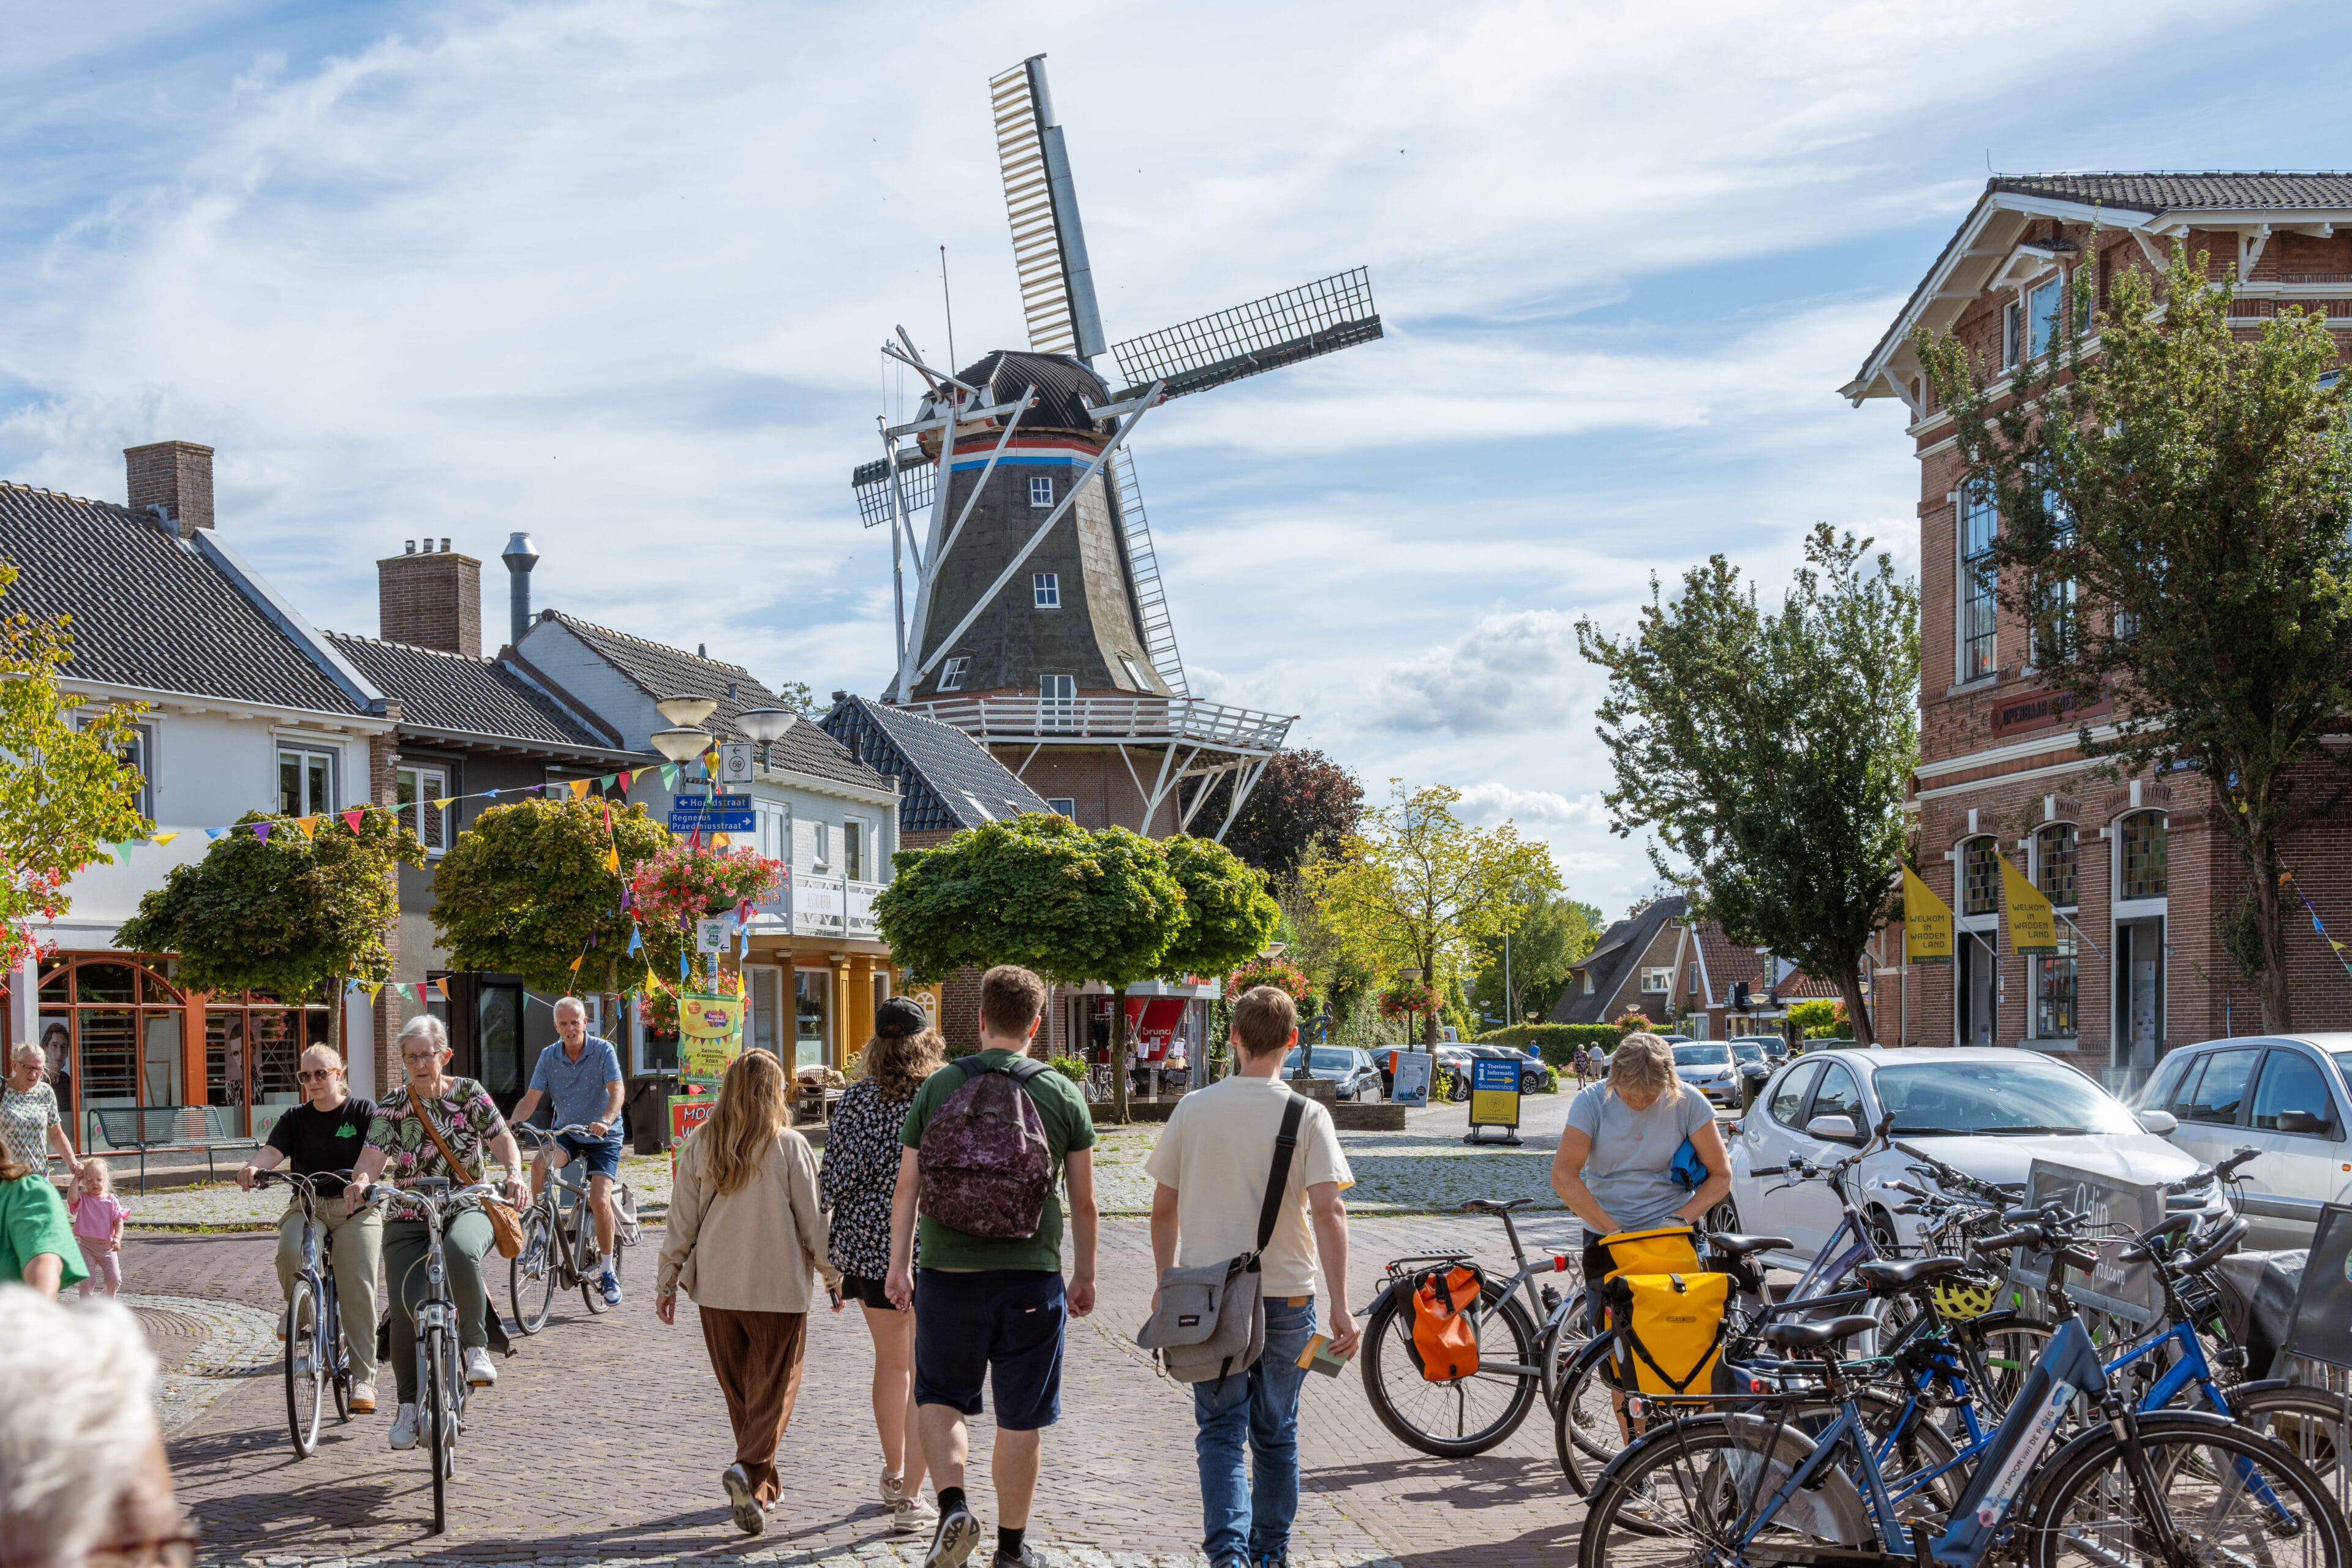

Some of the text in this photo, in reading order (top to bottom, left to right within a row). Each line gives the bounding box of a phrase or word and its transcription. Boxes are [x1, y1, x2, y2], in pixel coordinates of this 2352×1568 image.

[1142, 1027, 1171, 1035] bruna
[2074, 1182, 2108, 1240] Odin
[1997, 1484, 2007, 1501] het
[2005, 1458, 2024, 1487] SPOOR
[2021, 1445, 2032, 1460] van
[2030, 1433, 2039, 1446] DE
[2037, 1409, 2054, 1434] PLOEG
